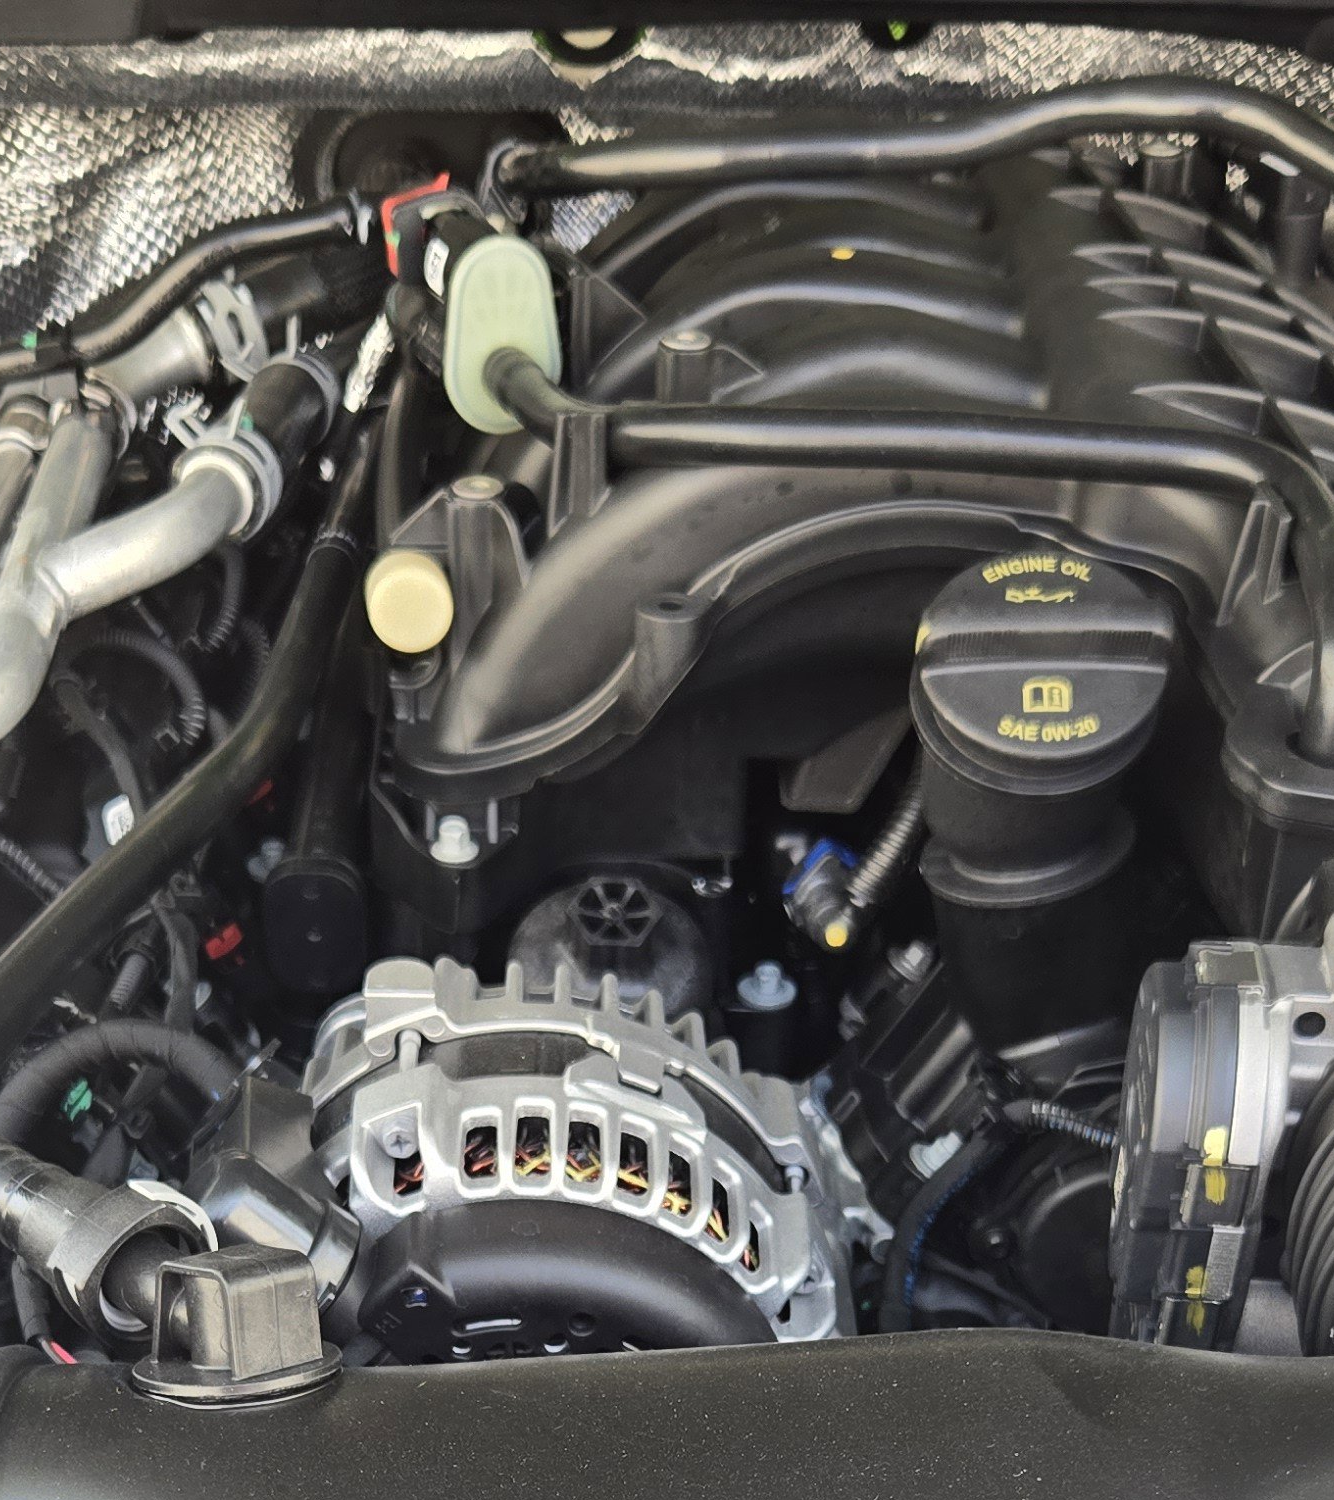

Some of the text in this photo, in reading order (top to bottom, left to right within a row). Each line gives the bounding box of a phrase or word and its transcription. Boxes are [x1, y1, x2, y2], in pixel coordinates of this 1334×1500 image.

[982, 554, 1093, 583] ENGINE OIL
[997, 713, 1100, 742] SAE 0W-20
